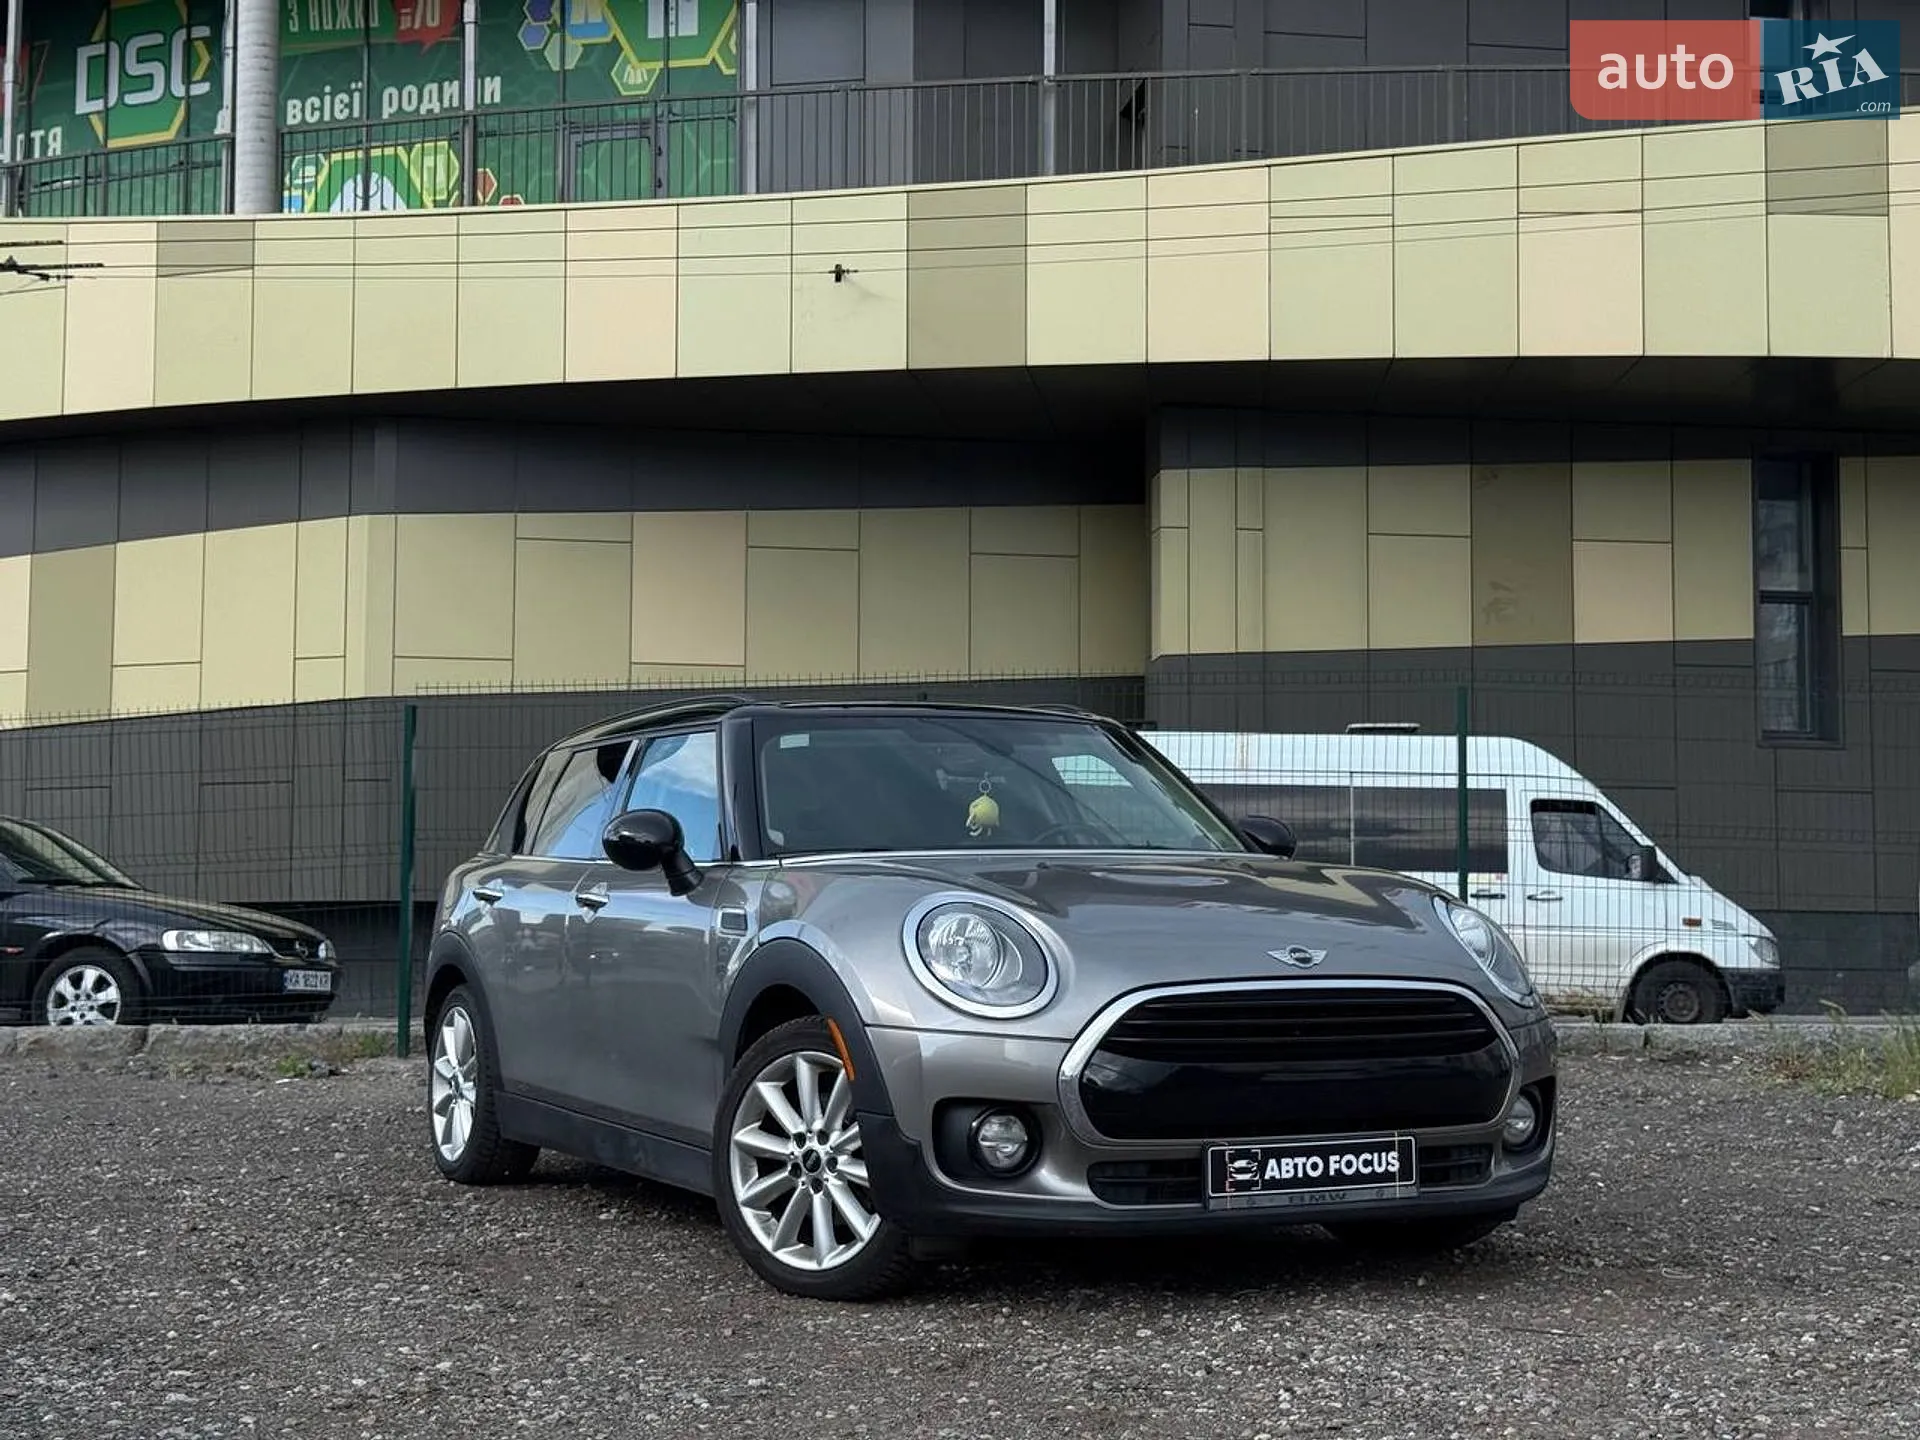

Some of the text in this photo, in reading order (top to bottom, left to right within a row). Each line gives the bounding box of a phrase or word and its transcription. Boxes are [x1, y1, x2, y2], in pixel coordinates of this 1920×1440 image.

[75, 25, 212, 116] DSC
[286, 75, 502, 126] всієї родии
[1264, 1151, 1400, 1180] АВТО FOCUS
